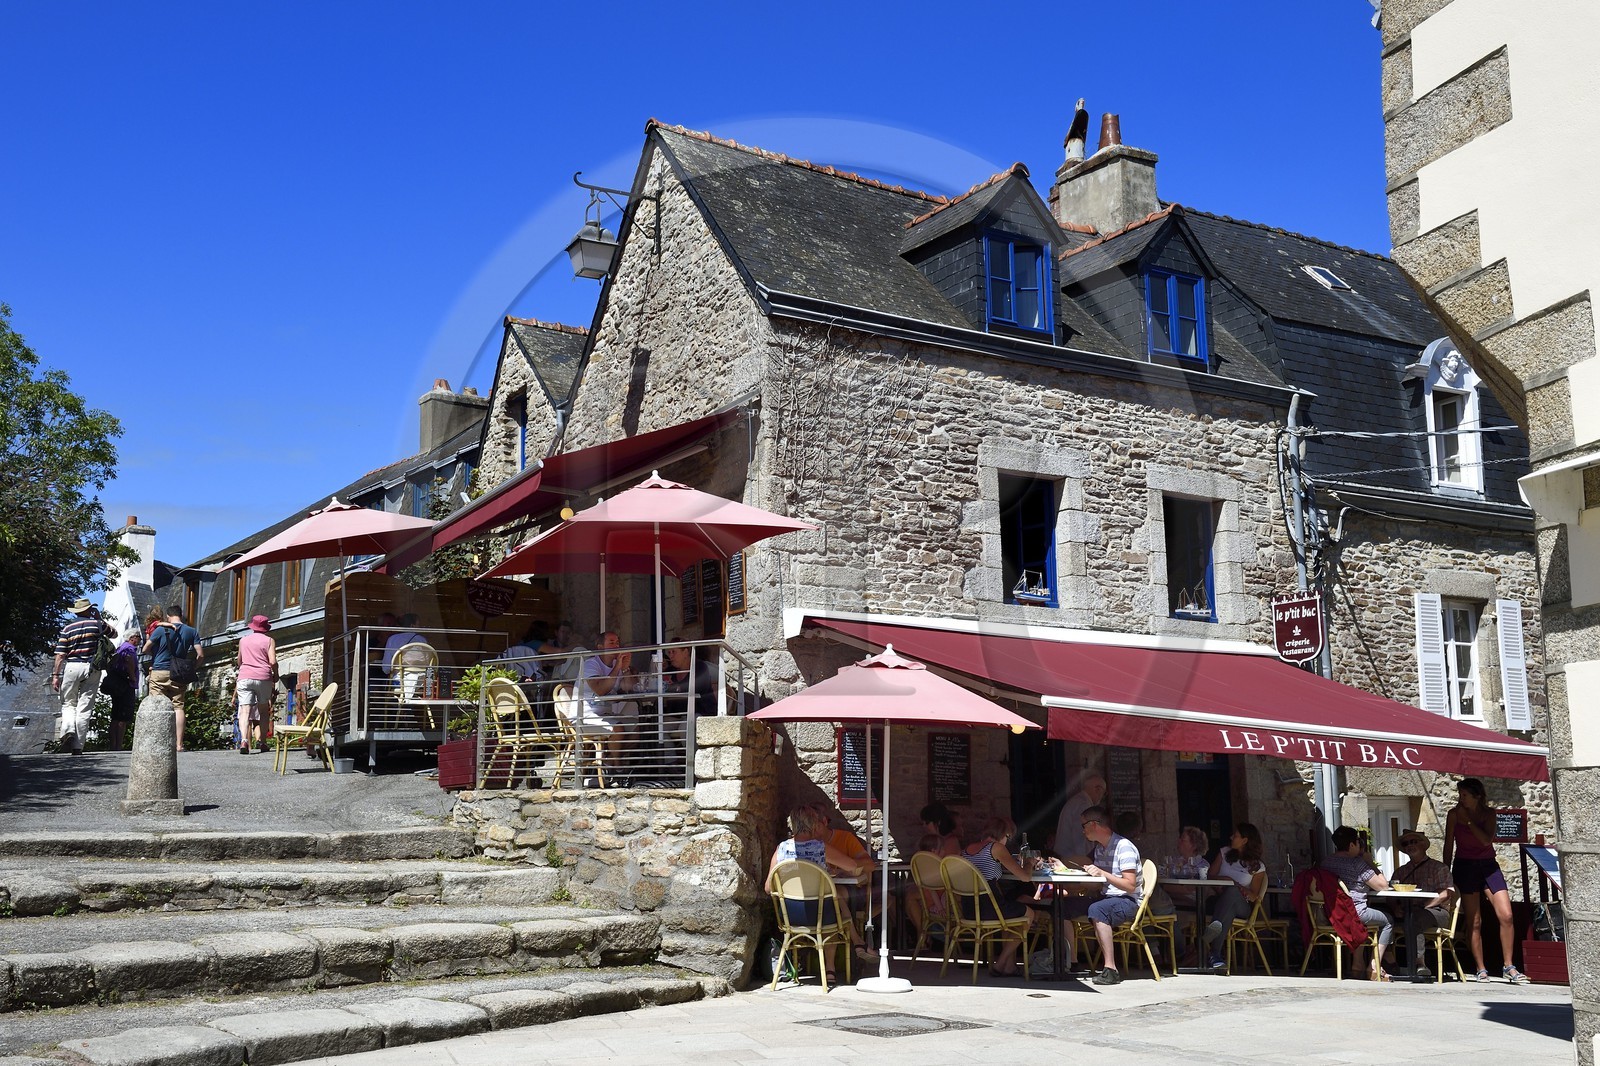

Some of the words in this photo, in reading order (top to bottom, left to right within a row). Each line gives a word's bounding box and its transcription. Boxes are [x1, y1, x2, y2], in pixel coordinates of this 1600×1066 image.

[1276, 609, 1283, 621] le
[1284, 606, 1300, 622] p'tit
[1302, 605, 1316, 618] bac
[1285, 638, 1310, 647] crêperie
[1282, 646, 1315, 656] restaurant
[1219, 729, 1265, 751] LE
[1271, 734, 1346, 761] P'TIT
[1358, 743, 1423, 766] BAC
